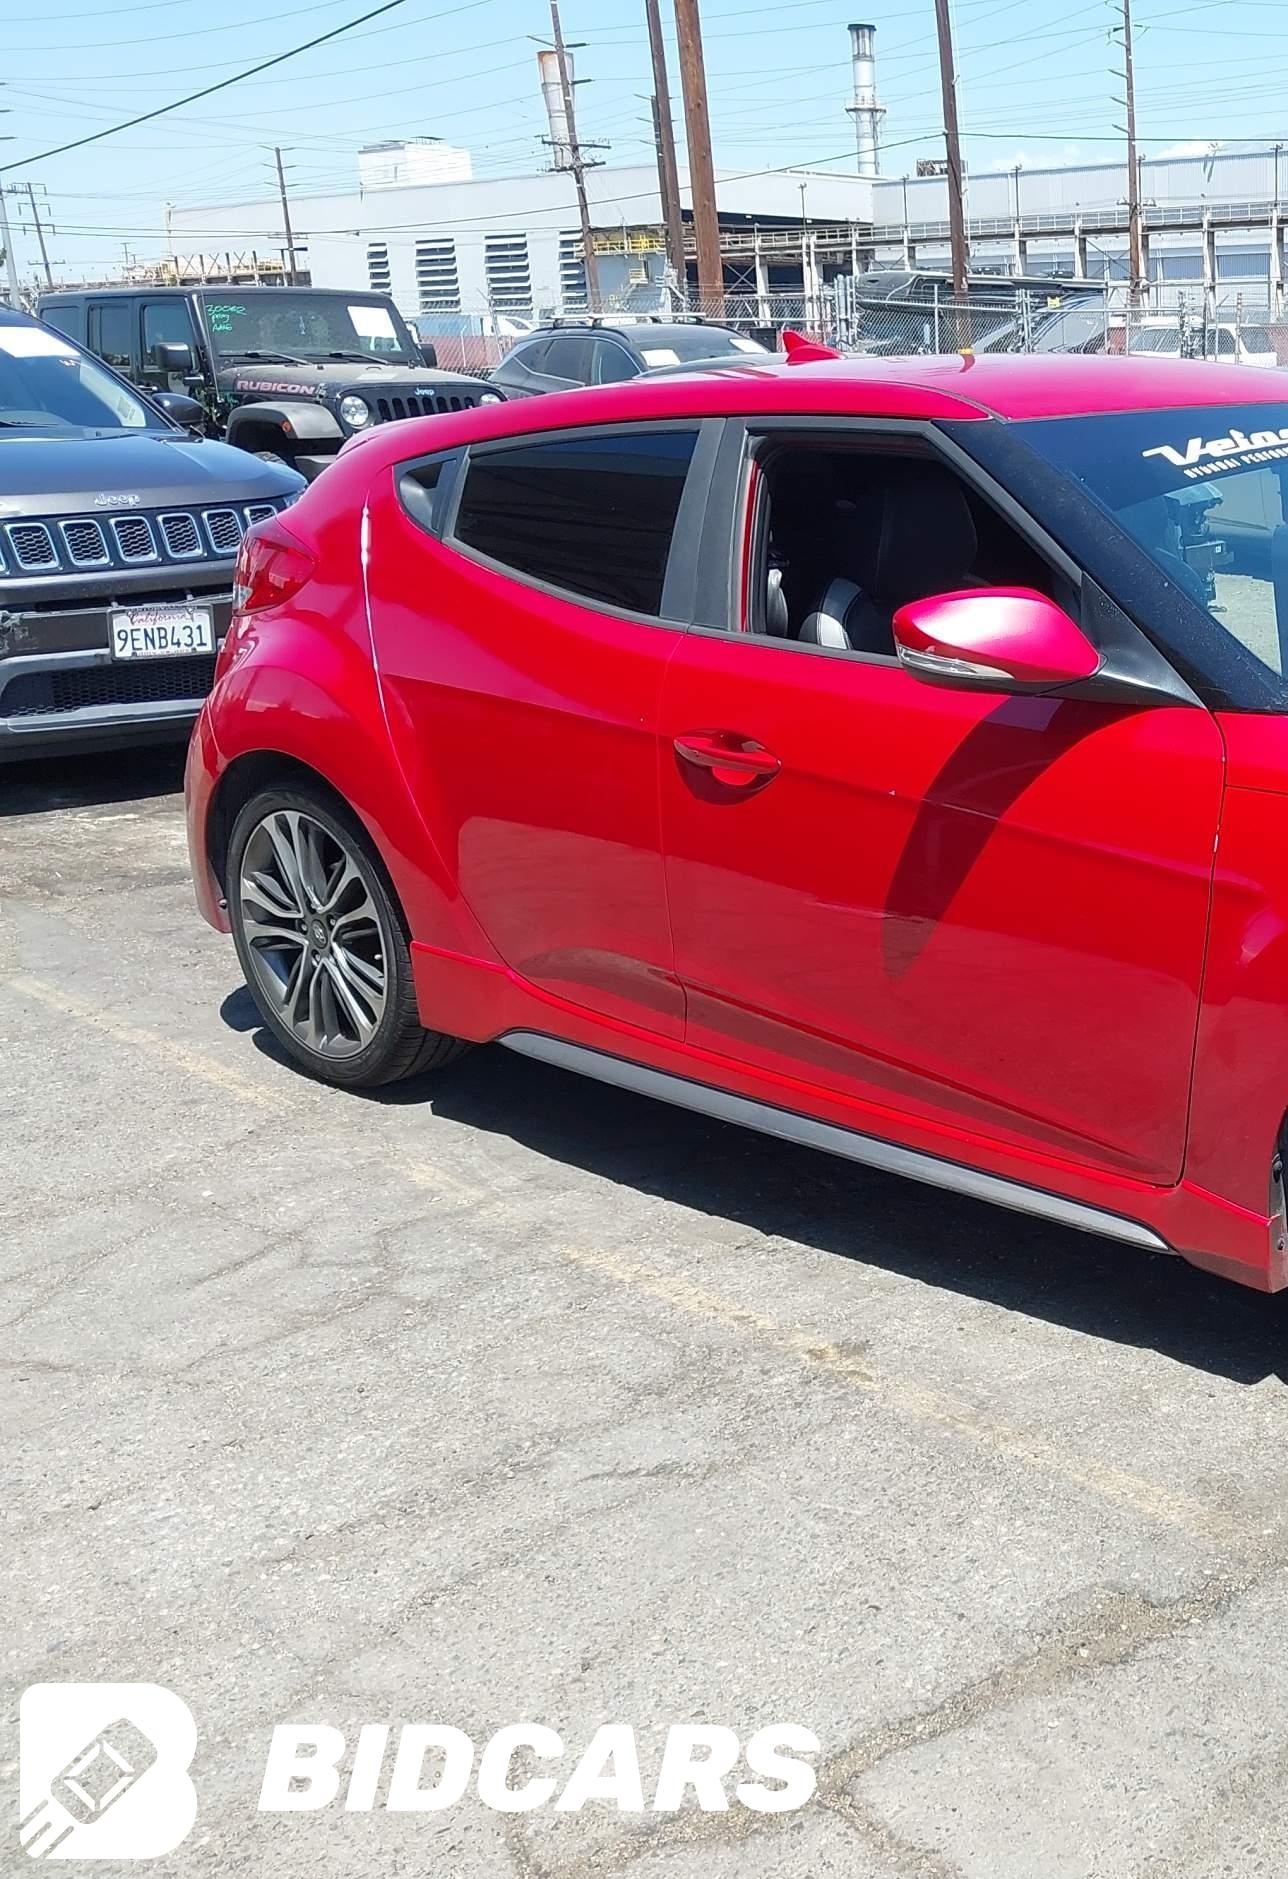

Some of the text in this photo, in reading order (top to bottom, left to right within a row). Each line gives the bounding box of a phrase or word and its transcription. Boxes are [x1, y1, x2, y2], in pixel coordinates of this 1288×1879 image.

[236, 380, 316, 395] RUBICON
[414, 387, 435, 397] Jeep
[94, 493, 141, 507] Jeep
[116, 624, 207, 653] 9ENB431
